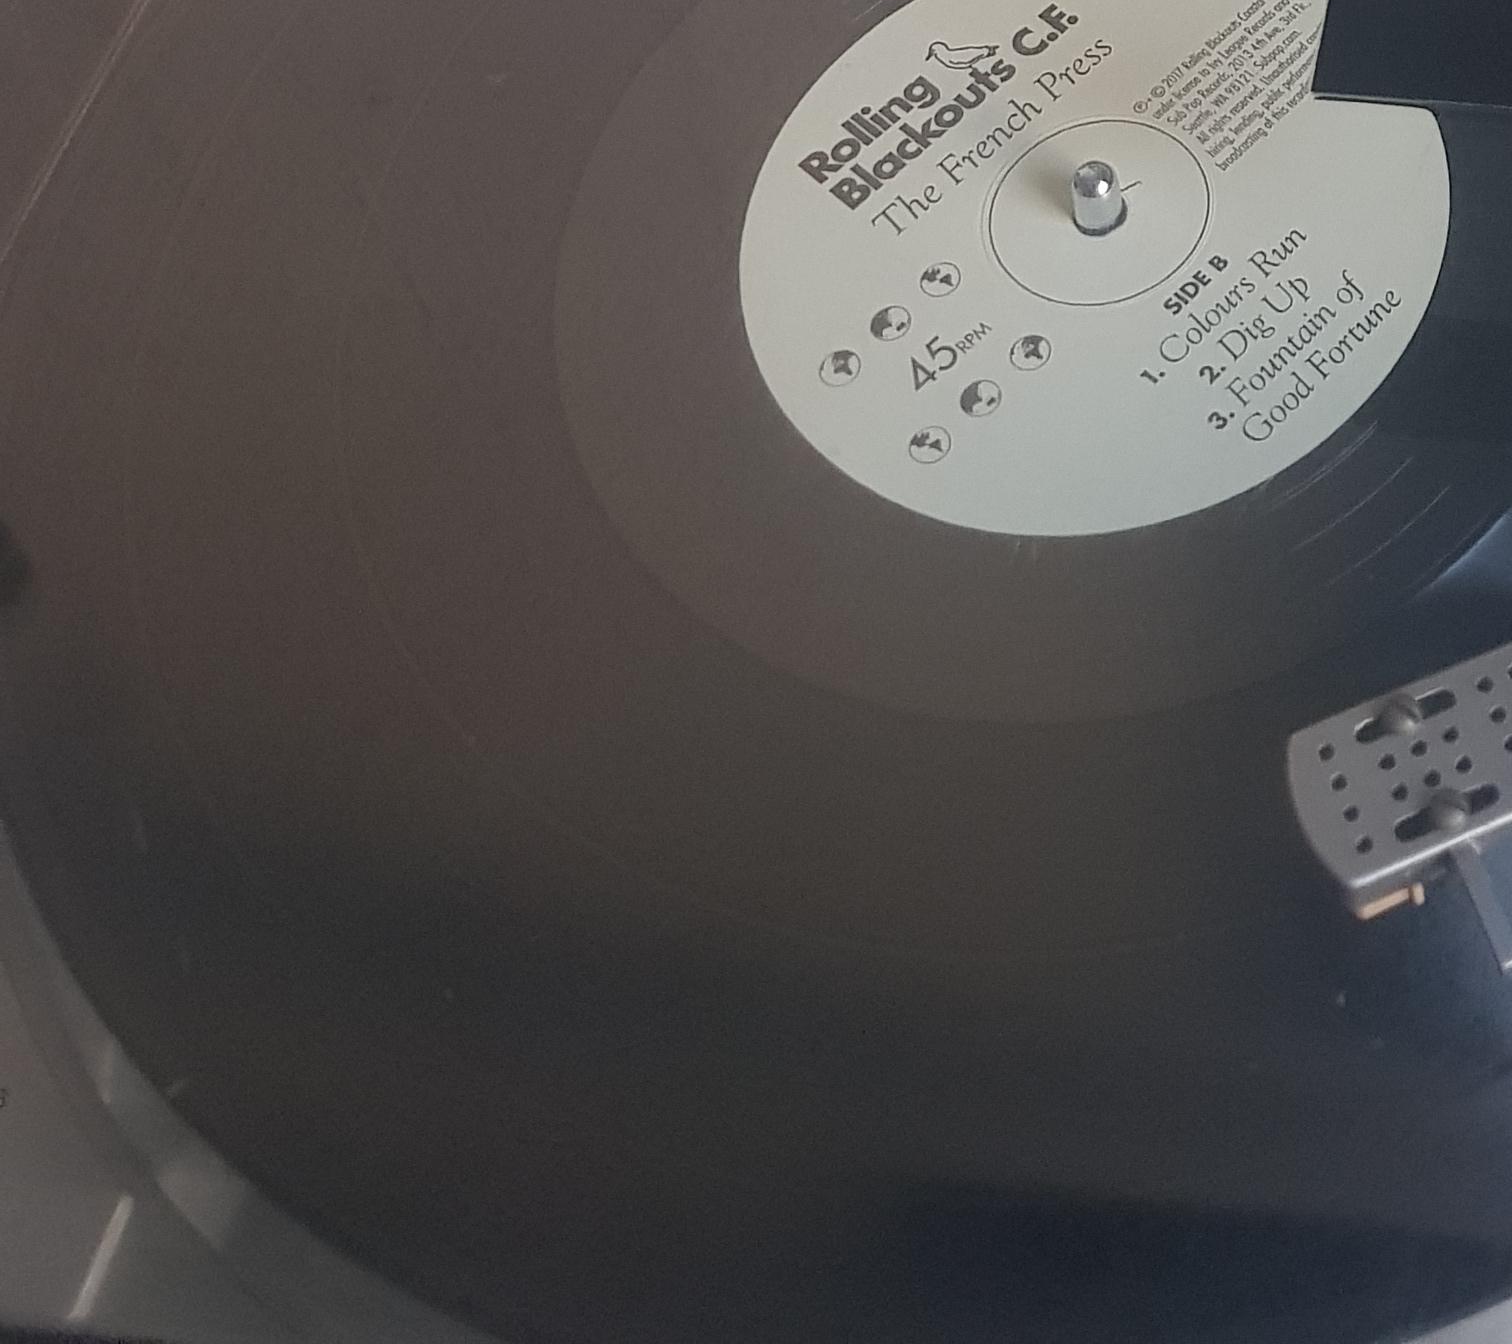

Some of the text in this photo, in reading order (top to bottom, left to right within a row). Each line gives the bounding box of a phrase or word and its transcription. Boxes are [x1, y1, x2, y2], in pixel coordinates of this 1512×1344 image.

[829, 4, 1078, 210] Blackouts C.F.
[1161, 66, 1184, 89] 2017
[1182, 98, 1202, 112] Pop
[1228, 49, 1254, 72] 2013
[1251, 39, 1268, 50] 4th
[1279, 10, 1297, 25] 3rd
[1198, 68, 1210, 77] to
[1210, 94, 1229, 108] WA
[798, 76, 940, 184] Rolling
[872, 40, 1112, 235] The French Press
[1264, 117, 1274, 129] of
[1140, 230, 1306, 383] 1. Colours Run
[1164, 256, 1228, 315] SIDE B
[1199, 278, 1310, 384] 2. Dig Up
[1208, 270, 1363, 429] 3. Fountain of
[1243, 291, 1401, 441] Good Fortune
